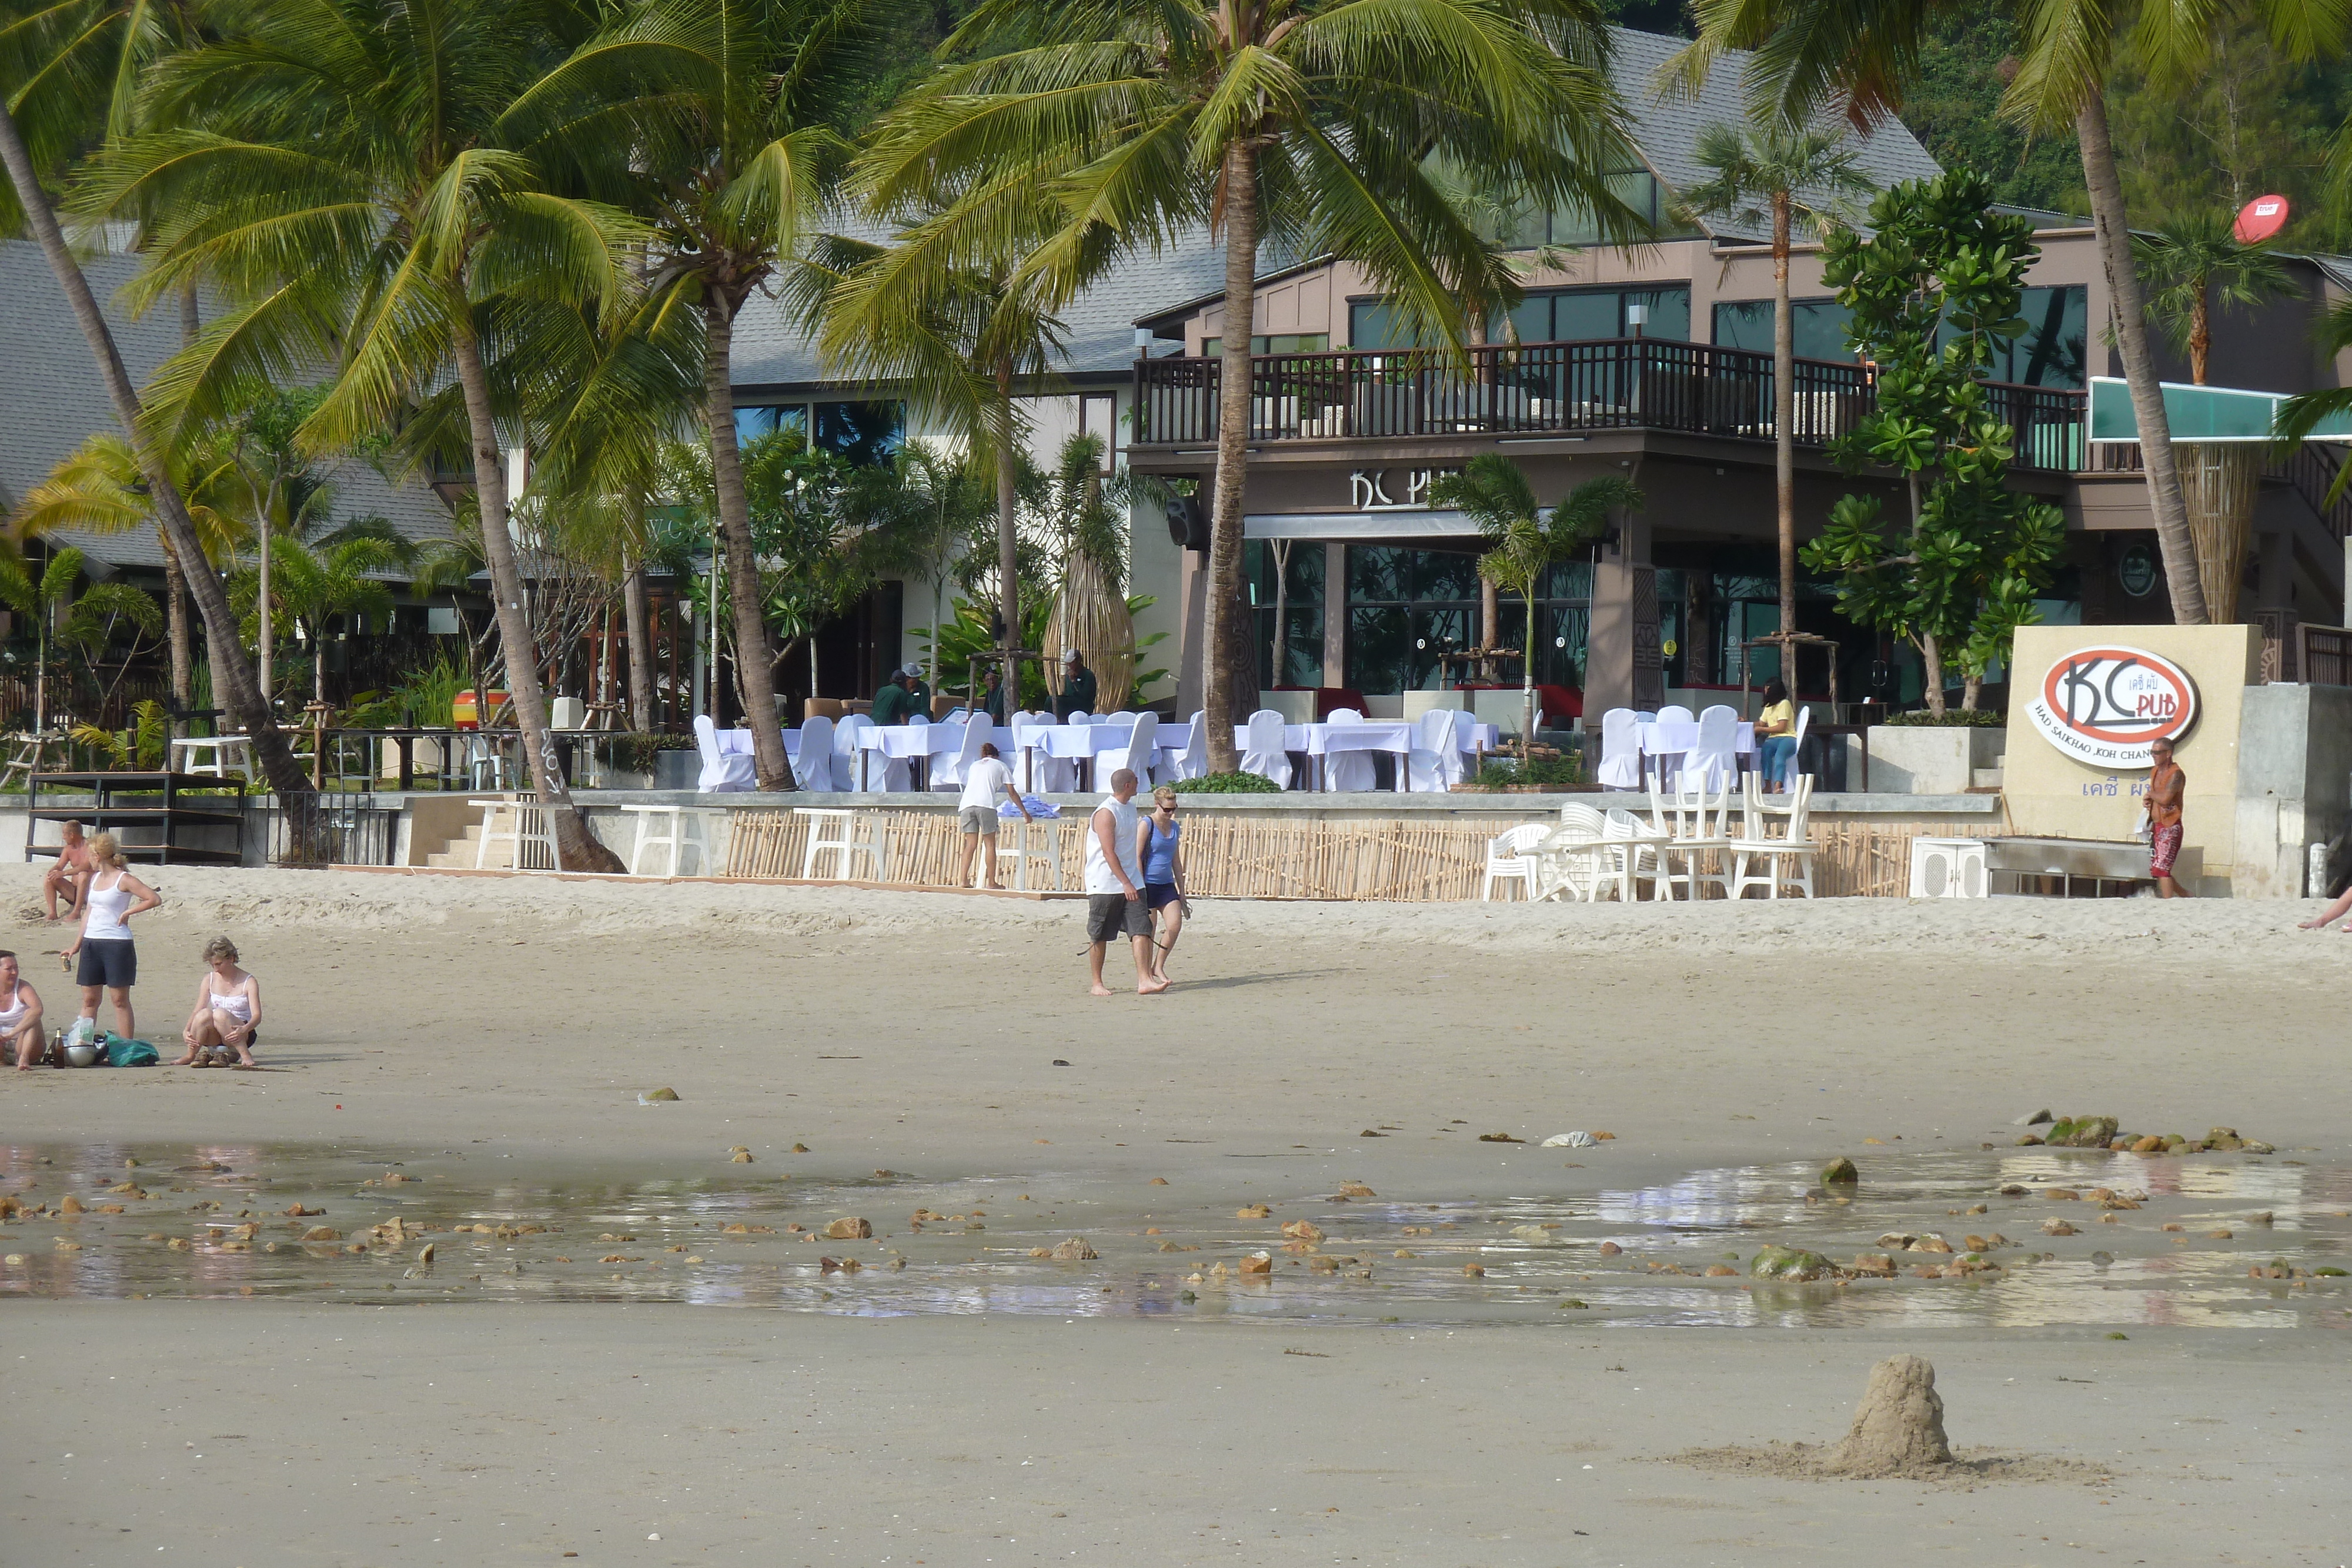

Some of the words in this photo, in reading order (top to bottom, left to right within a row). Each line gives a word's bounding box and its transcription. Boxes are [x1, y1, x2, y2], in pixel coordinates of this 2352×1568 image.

[2064, 657, 2140, 727] KC
[2136, 693, 2177, 717] PUB
[2034, 704, 2052, 727] HAD
[2051, 727, 2092, 753] SAIKHAO
[2121, 750, 2151, 760] CHAN
[2082, 776, 2119, 797] เคซี
